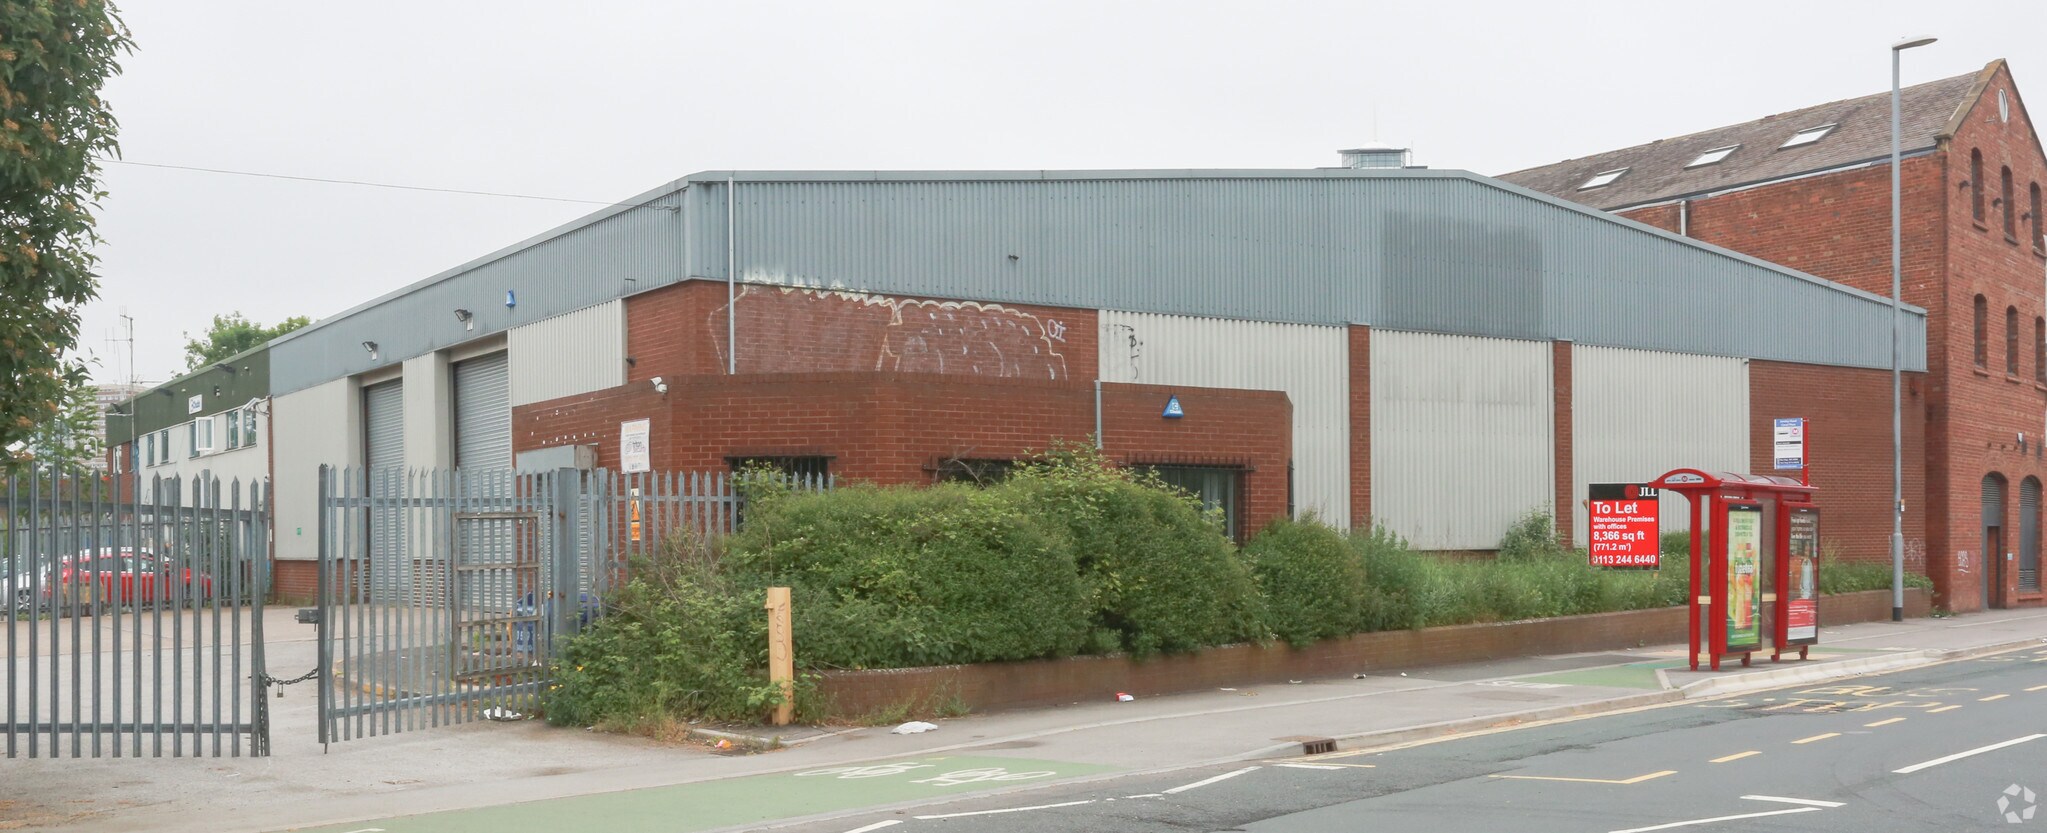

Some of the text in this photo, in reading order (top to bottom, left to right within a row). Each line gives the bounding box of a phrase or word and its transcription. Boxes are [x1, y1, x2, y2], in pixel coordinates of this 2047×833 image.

[1638, 486, 1658, 497] JLL
[1593, 501, 1638, 514] To Let
[1593, 530, 1645, 542] 8,366 sq ft
[1593, 543, 1617, 552] (771.2
[1593, 555, 1656, 564] 0113 244 6440
